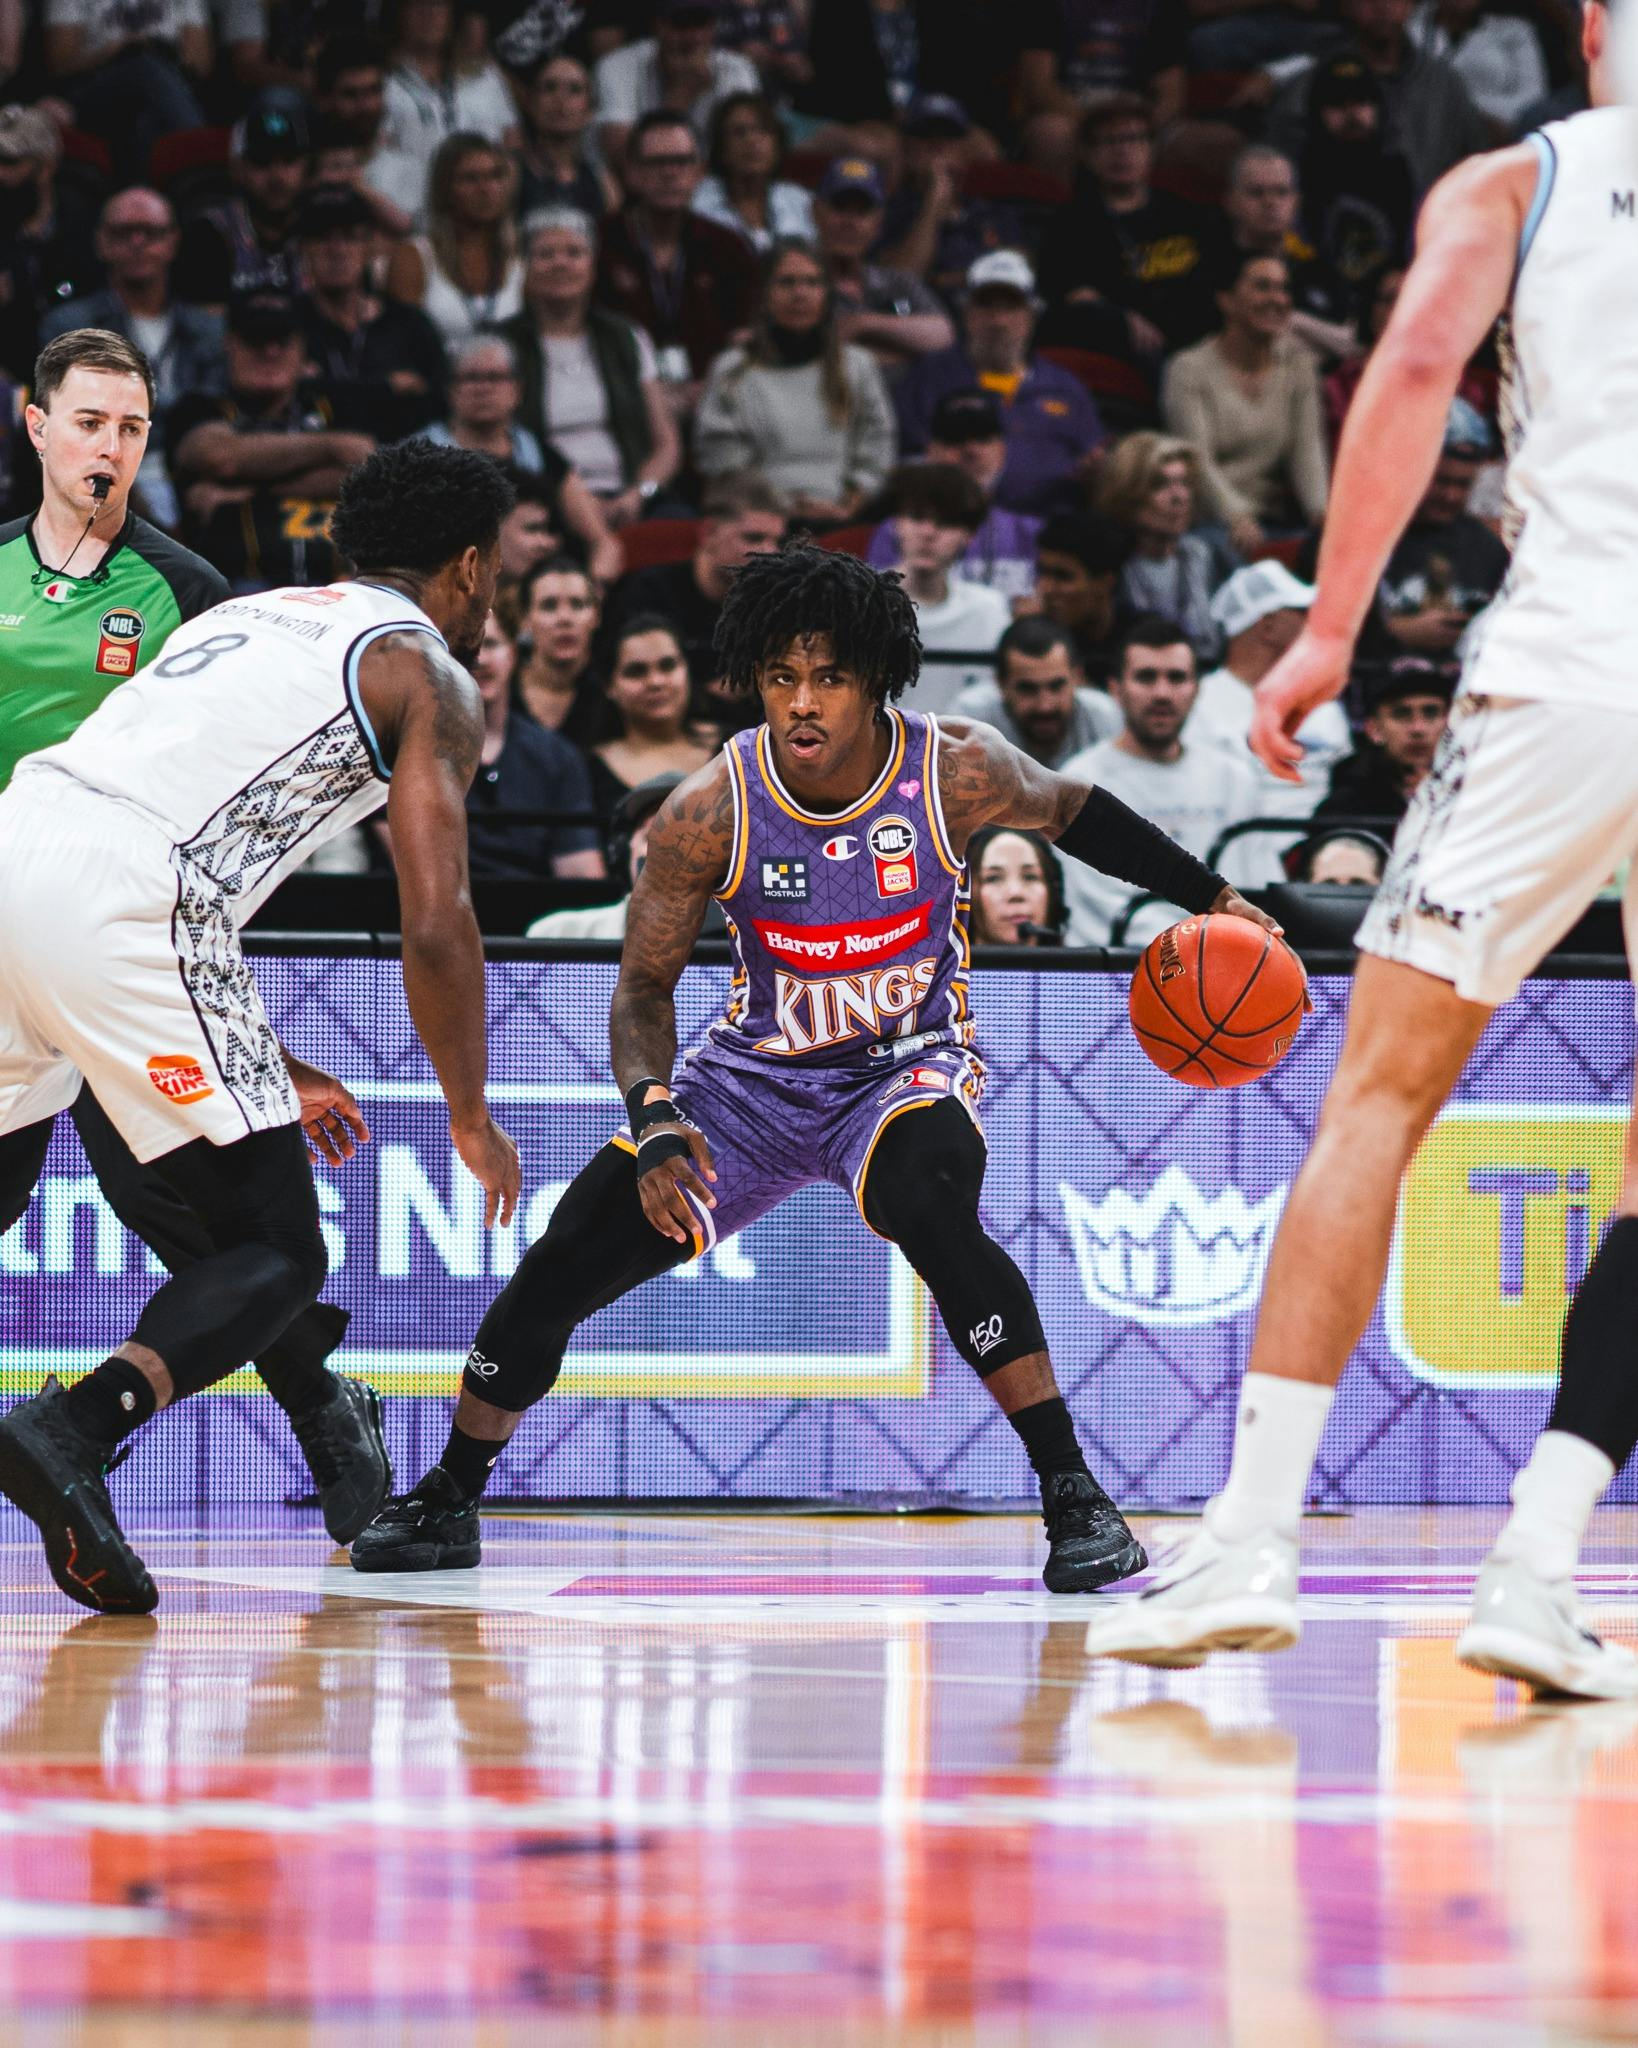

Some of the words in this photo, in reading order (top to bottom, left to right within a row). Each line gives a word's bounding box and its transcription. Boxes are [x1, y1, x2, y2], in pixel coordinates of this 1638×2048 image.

[108, 617, 135, 635] NBL
[153, 633, 250, 678] 8
[878, 829, 906, 850] NBL
[764, 890, 806, 898] HOSTPLUS
[765, 931, 840, 960] Harvey
[844, 917, 920, 955] Norman
[752, 957, 937, 1056] KINGS
[1467, 1167, 1592, 1296] Ti
[970, 1314, 1003, 1353] 150
